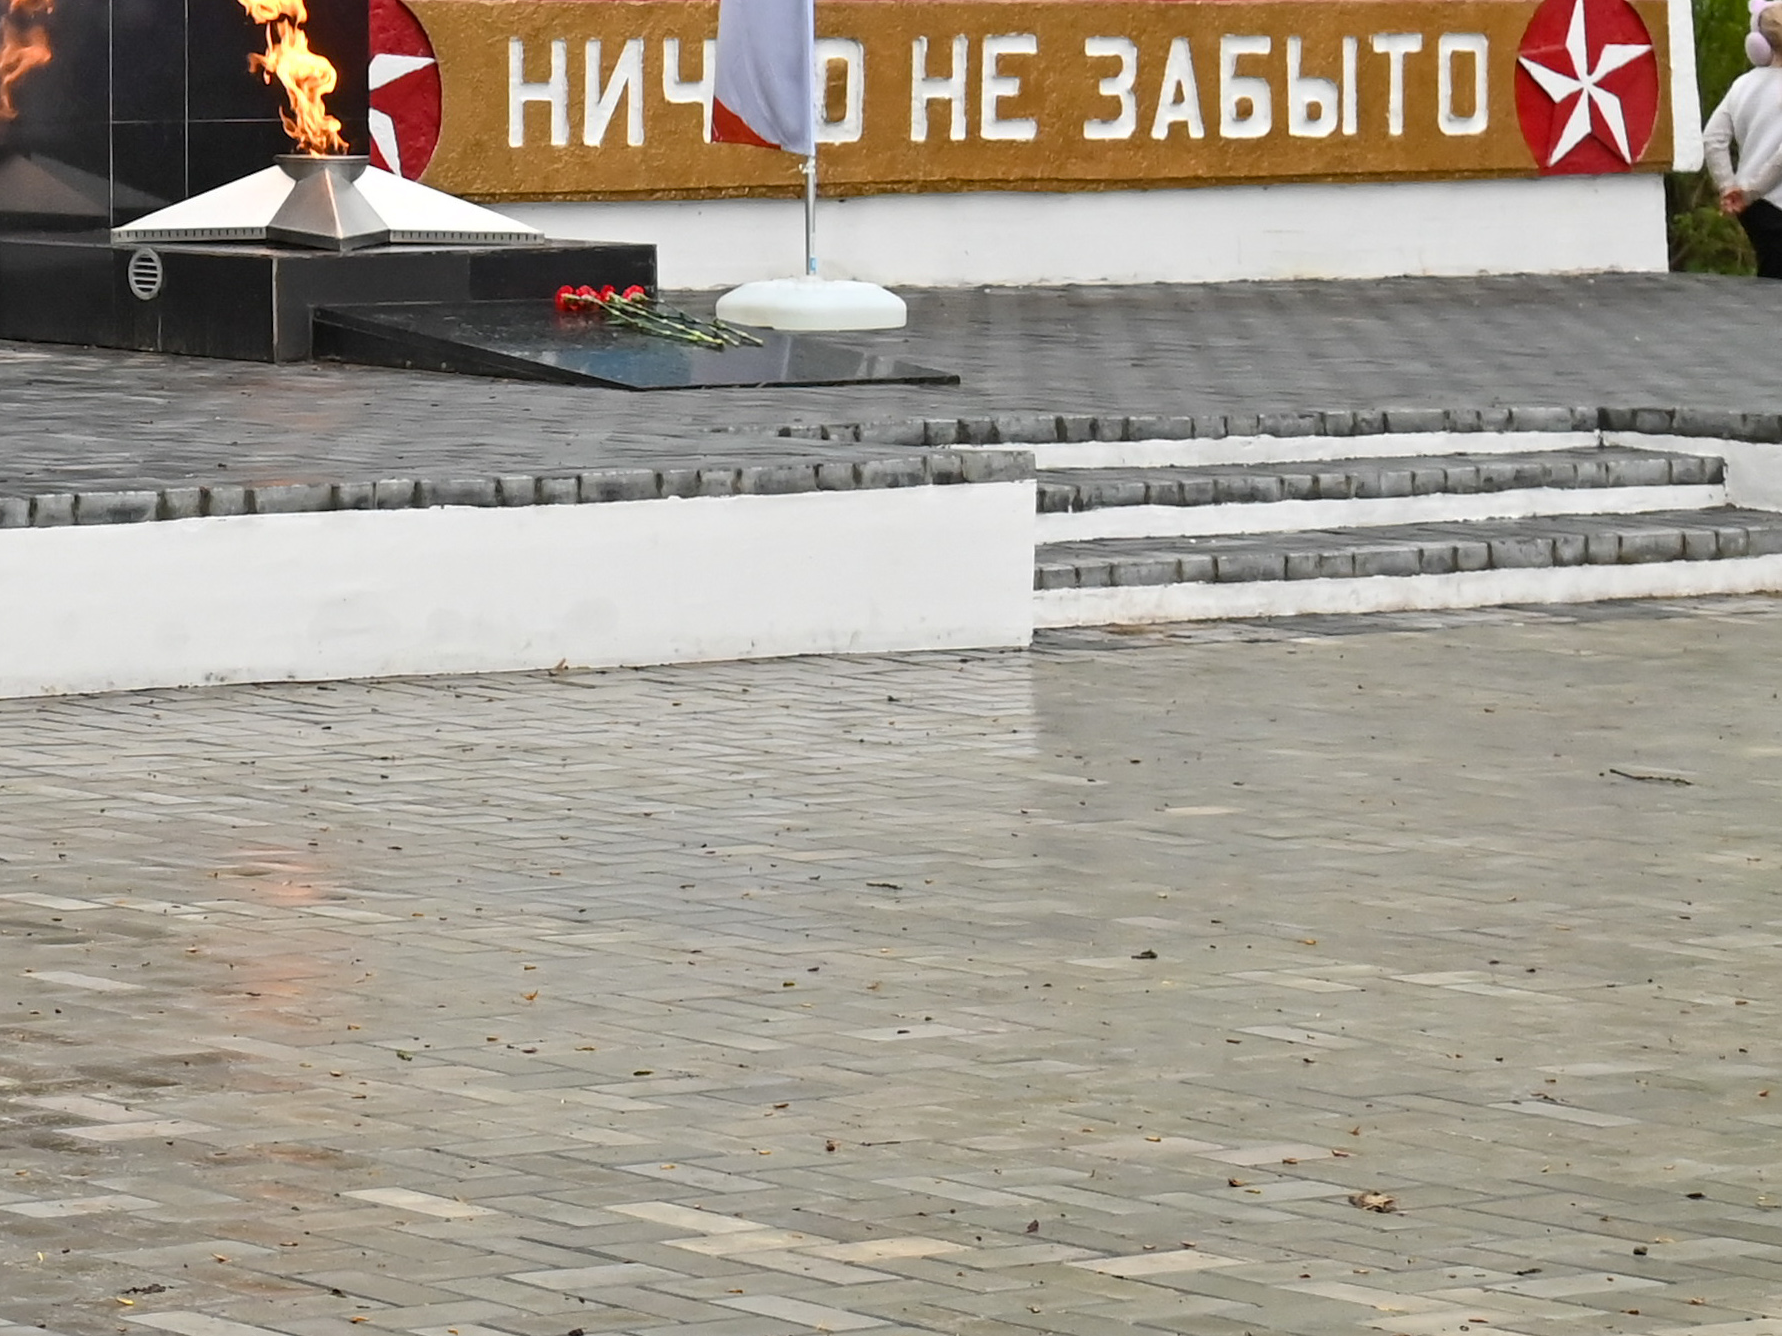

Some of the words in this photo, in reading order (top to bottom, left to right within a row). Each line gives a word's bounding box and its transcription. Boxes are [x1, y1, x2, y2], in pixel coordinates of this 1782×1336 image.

[508, 35, 864, 148] НИЧО
[910, 33, 1038, 142] НЕ
[1083, 32, 1489, 141] ЗАБЫТО
